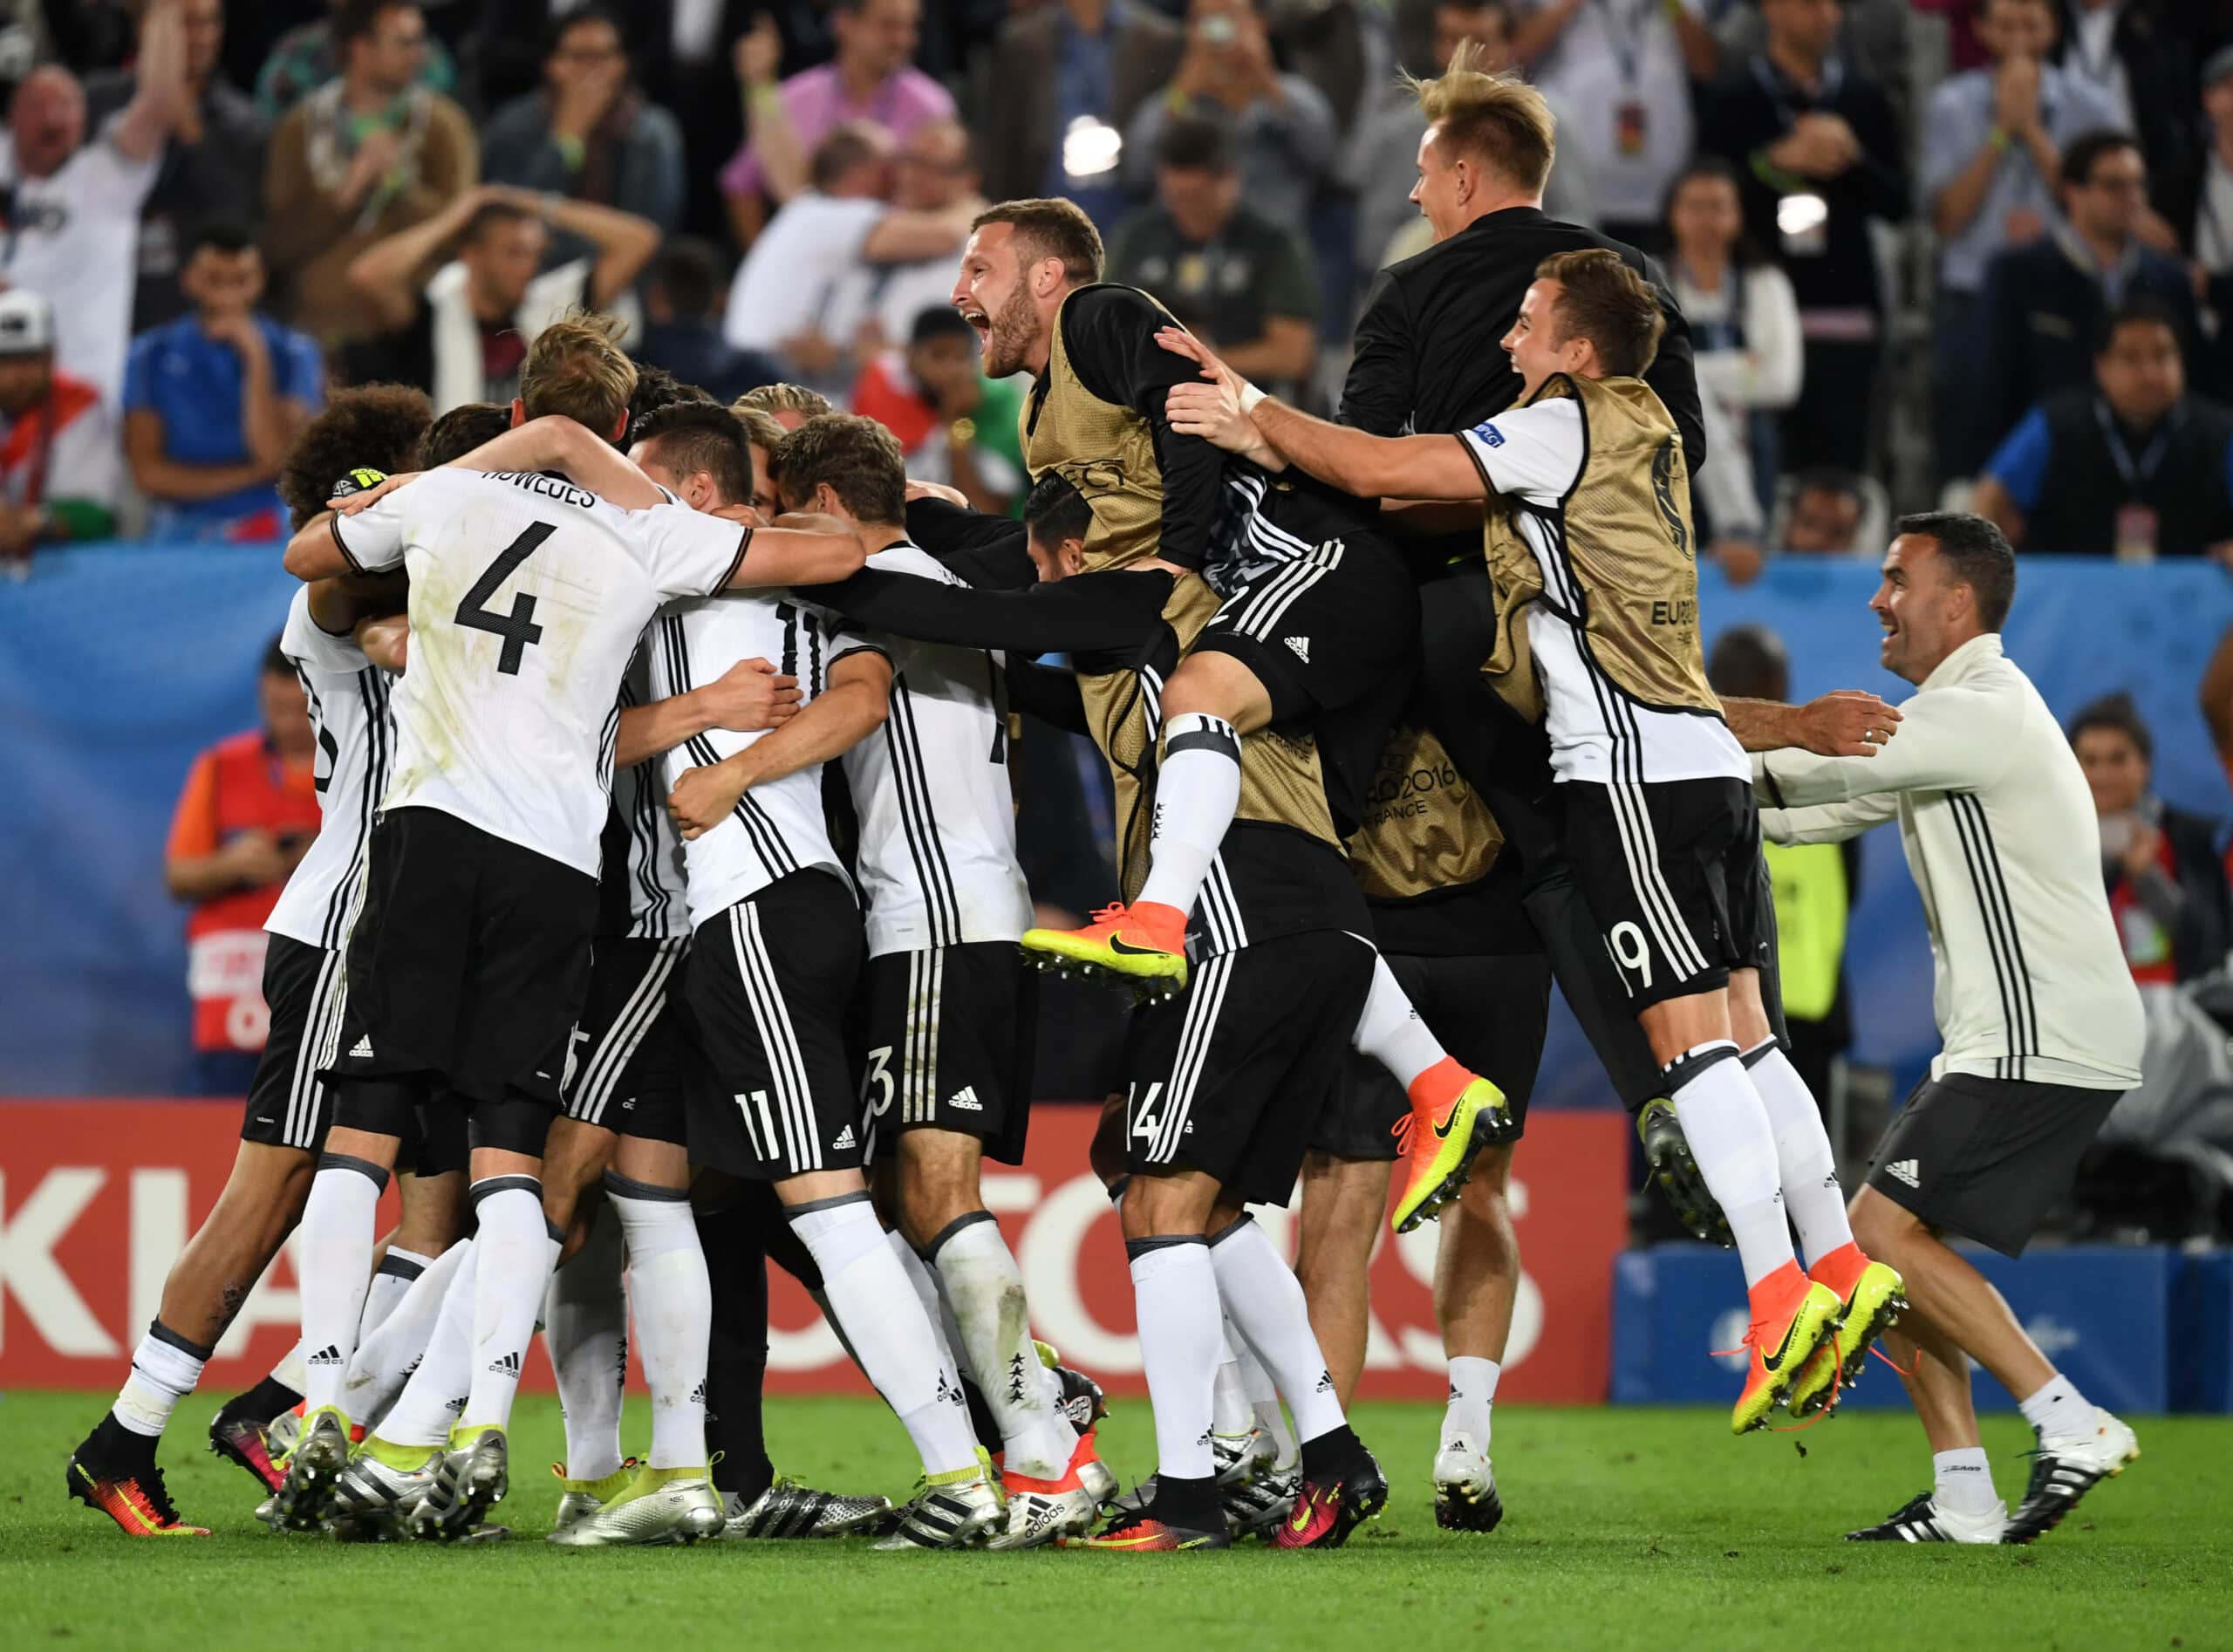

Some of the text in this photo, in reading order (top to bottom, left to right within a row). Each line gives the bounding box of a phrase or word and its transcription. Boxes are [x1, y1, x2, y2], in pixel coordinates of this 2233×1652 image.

[454, 520, 558, 676] 4
[734, 1090, 780, 1161] 11
[1127, 1082, 1164, 1151] 14
[1024, 1503, 1066, 1539] adidas
